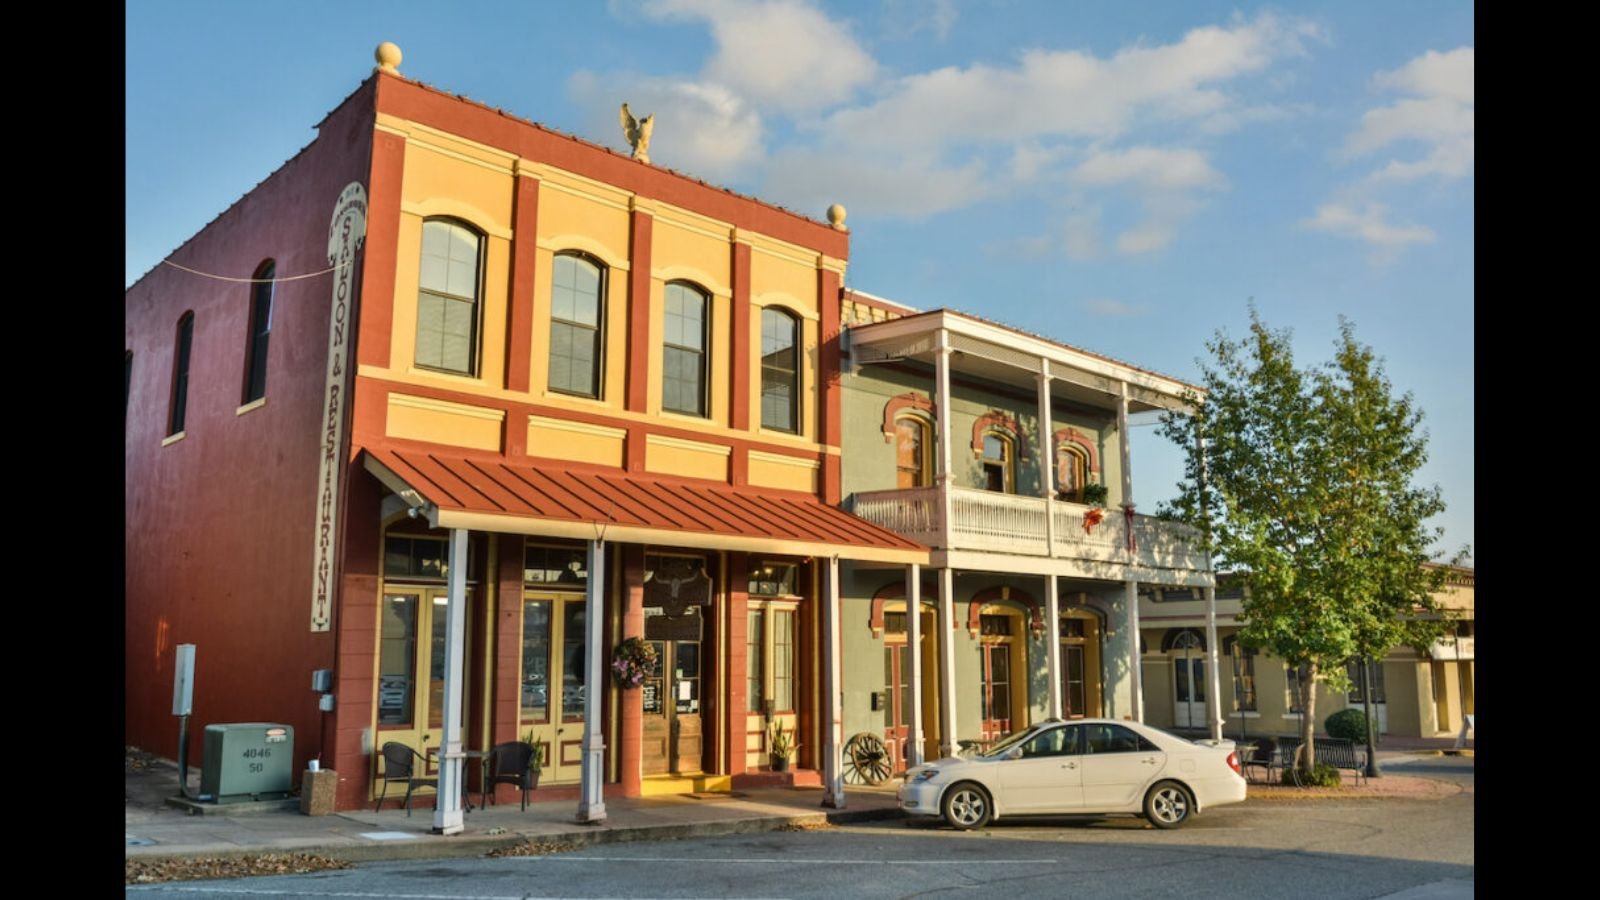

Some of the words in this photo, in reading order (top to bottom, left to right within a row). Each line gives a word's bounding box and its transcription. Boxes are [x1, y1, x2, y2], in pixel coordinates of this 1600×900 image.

[334, 215, 351, 347] SALOON
[333, 353, 342, 377] &
[317, 384, 340, 618] RESTAURANT
[242, 748, 271, 759] 4046
